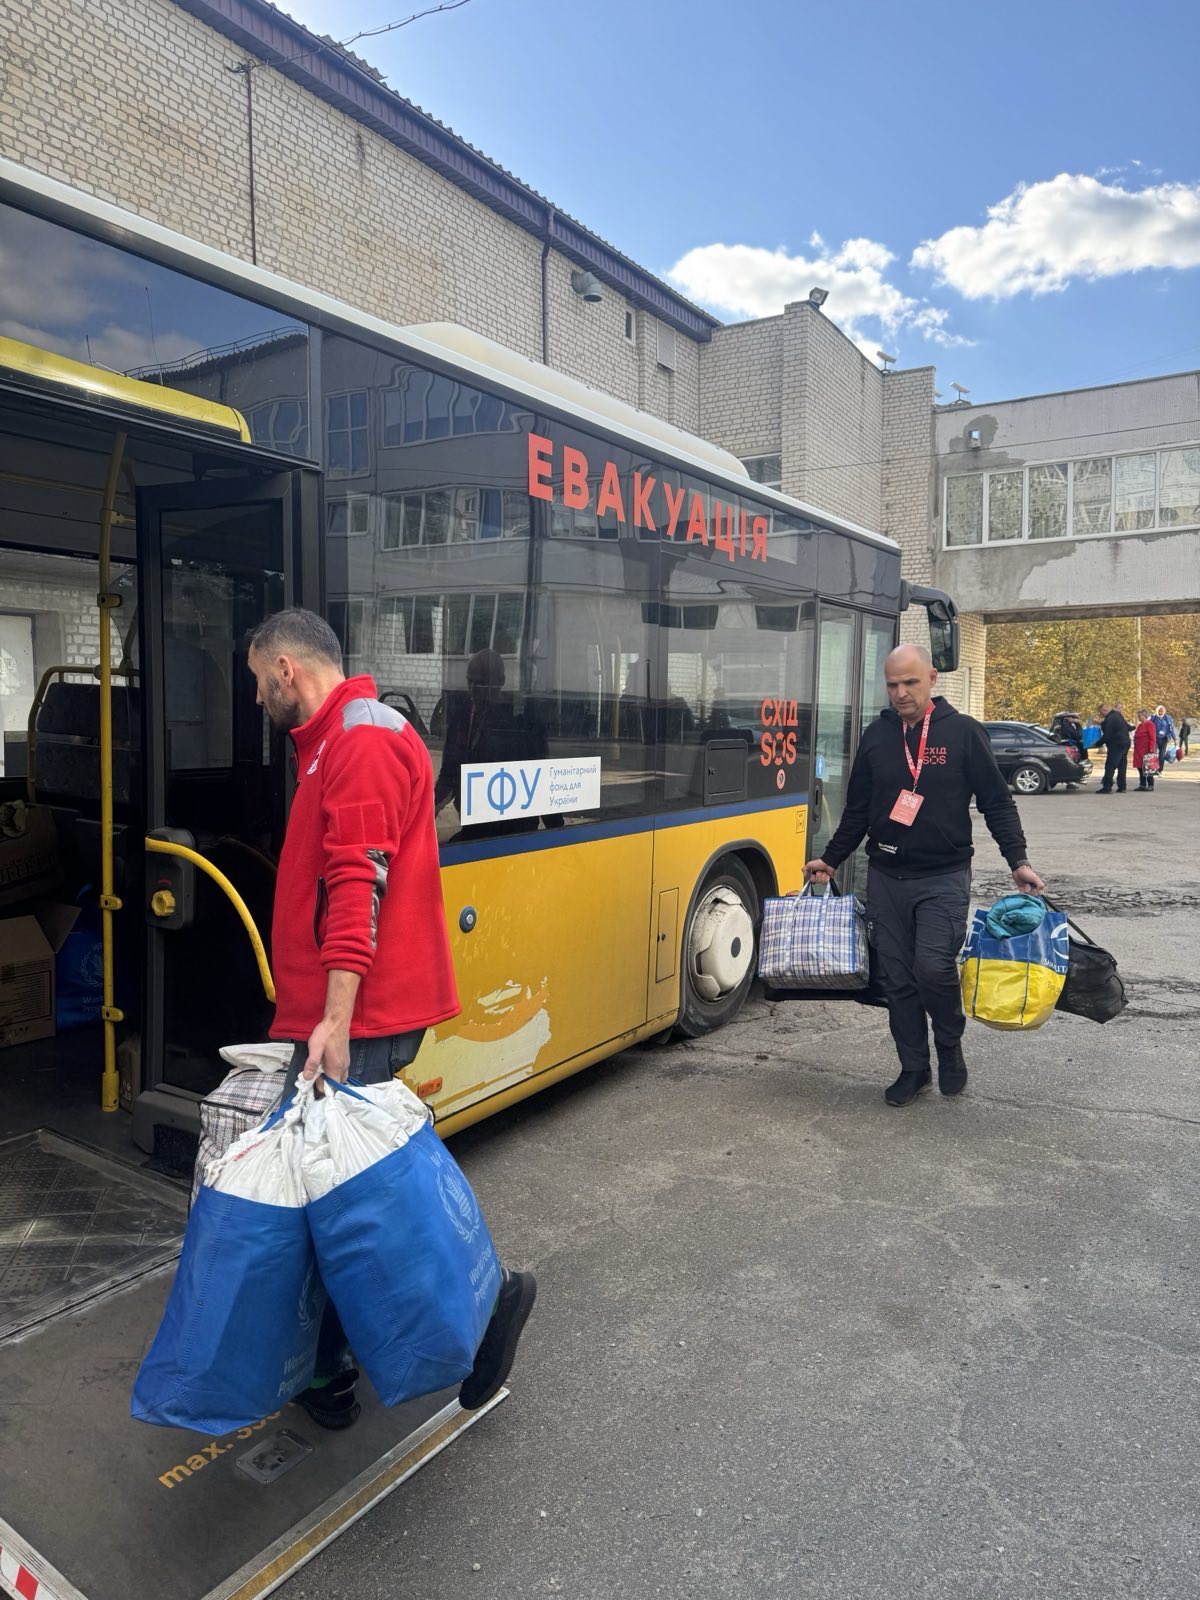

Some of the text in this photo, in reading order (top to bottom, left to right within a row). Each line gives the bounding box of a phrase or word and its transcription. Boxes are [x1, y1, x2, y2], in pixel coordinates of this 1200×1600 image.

[528, 432, 767, 562] ЕВАКУАЦІЯ
[761, 698, 798, 727] СХІД
[760, 732, 797, 766] SOS
[549, 764, 597, 780] Гуманітарний
[549, 781, 581, 792] фонд для
[466, 767, 542, 817] ГФУ
[549, 794, 578, 807] України
[158, 1441, 235, 1489] max.
